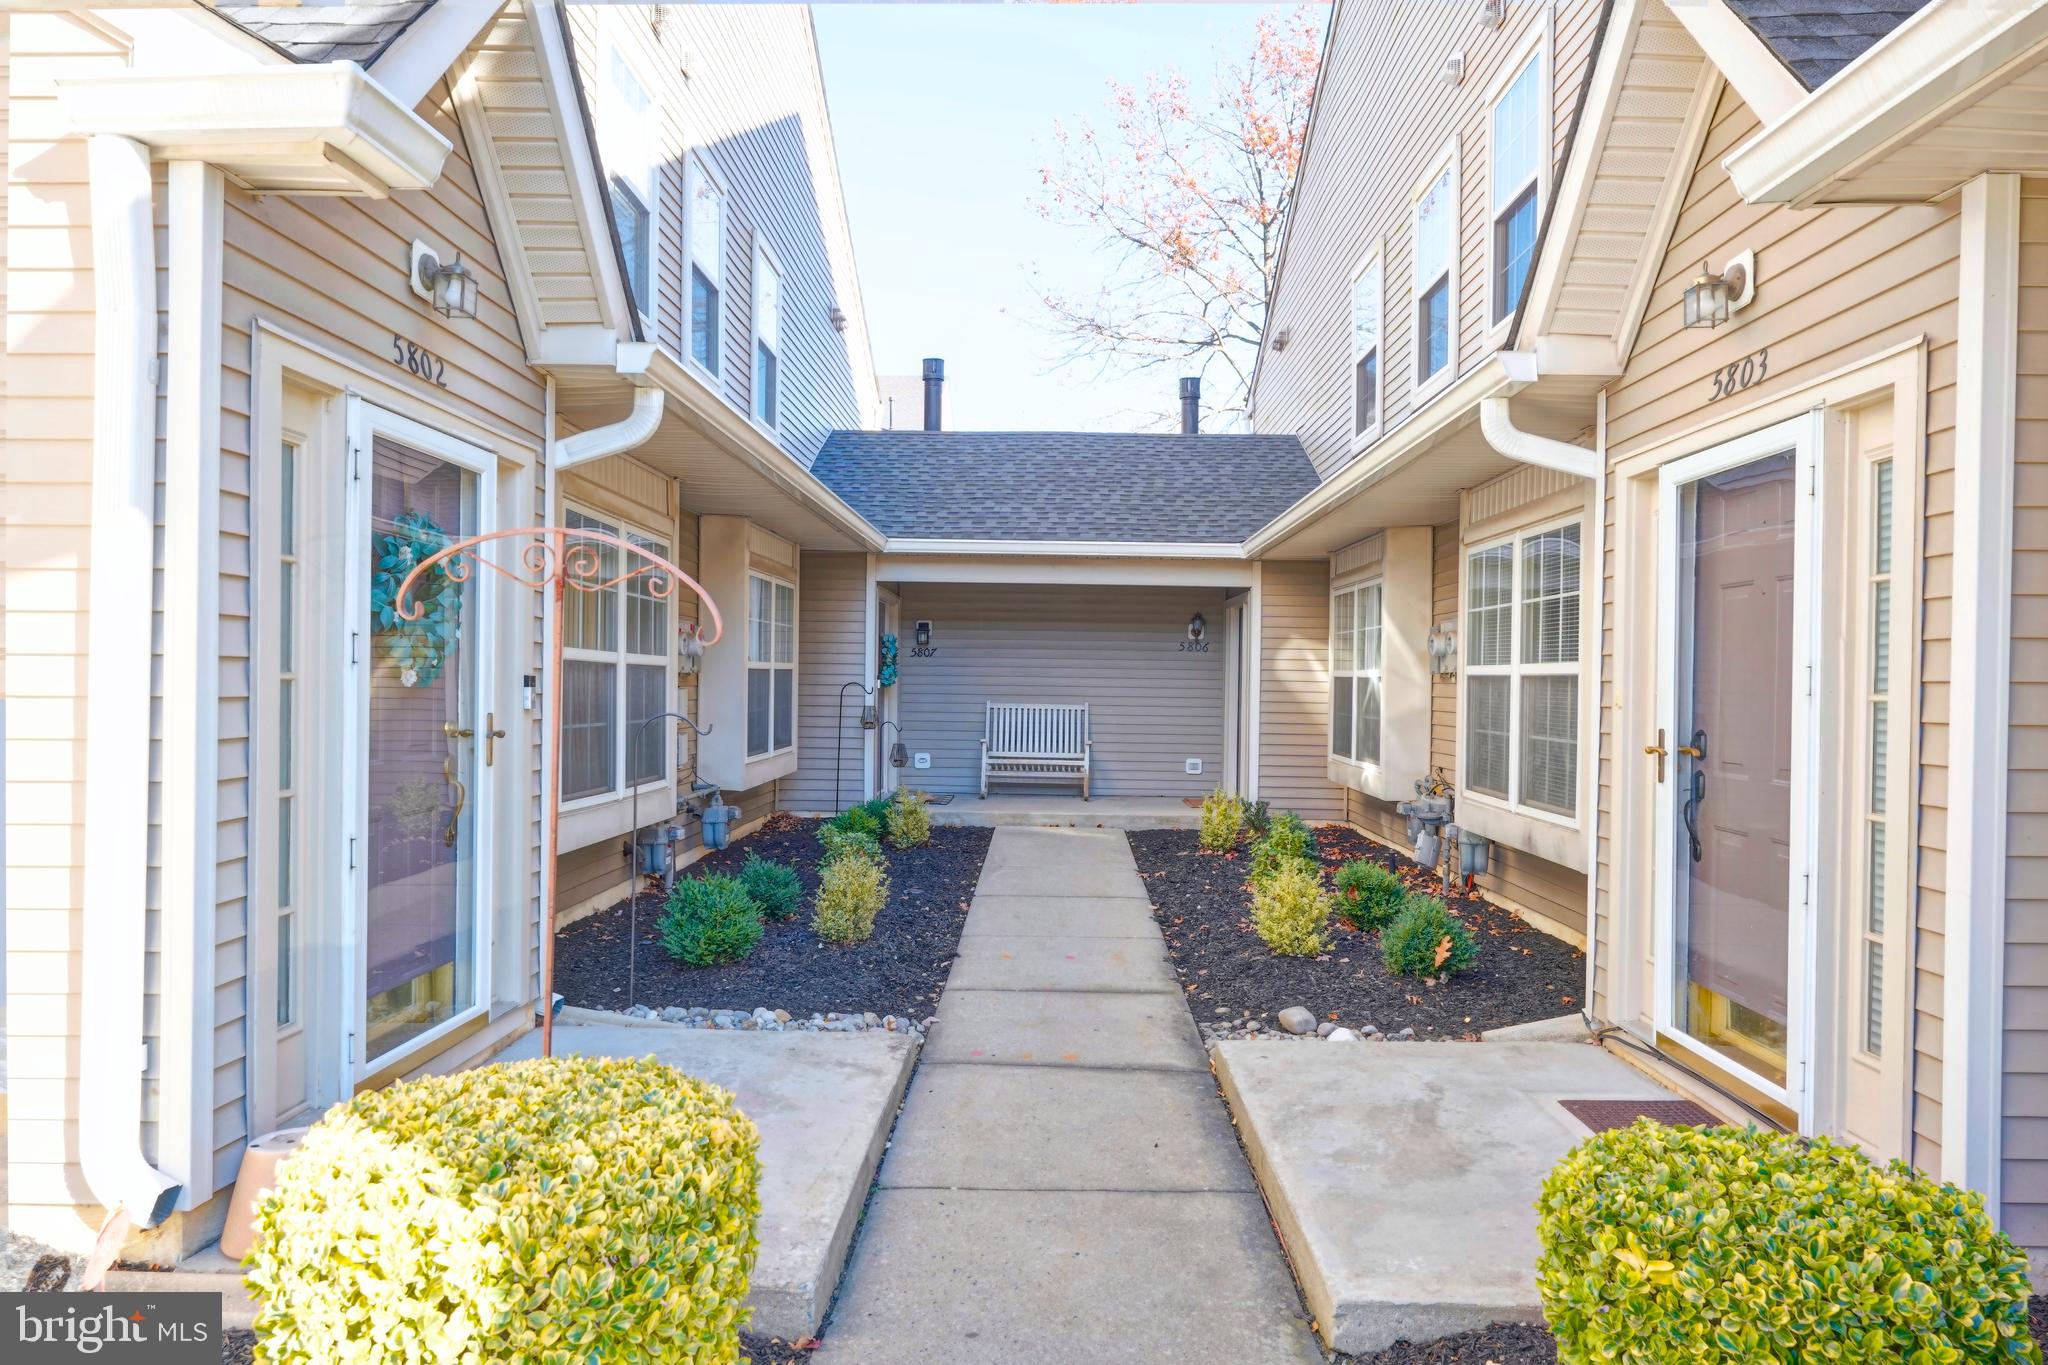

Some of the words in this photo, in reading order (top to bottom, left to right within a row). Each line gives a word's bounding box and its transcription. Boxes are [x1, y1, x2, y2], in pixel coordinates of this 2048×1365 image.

[393, 333, 447, 388] 5802
[1708, 347, 1768, 402] 5803
[910, 647, 938, 658] 5807
[1178, 641, 1210, 653] 5806
